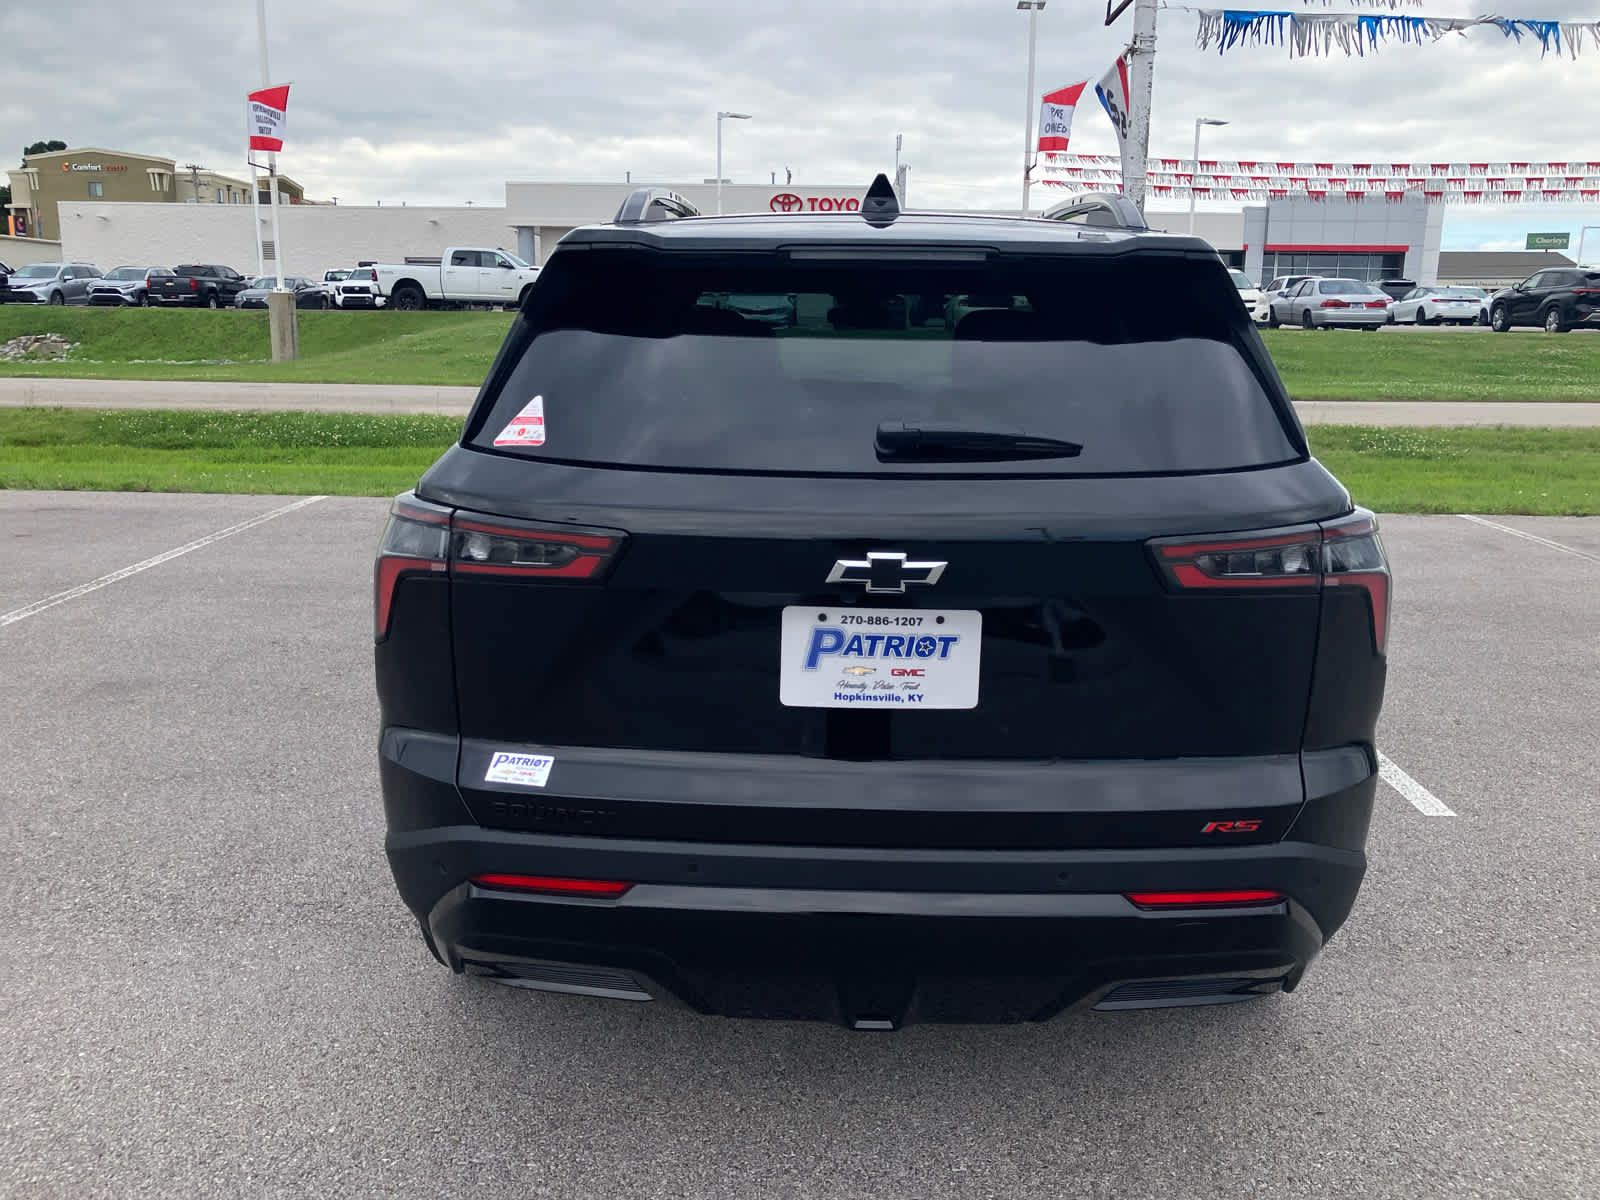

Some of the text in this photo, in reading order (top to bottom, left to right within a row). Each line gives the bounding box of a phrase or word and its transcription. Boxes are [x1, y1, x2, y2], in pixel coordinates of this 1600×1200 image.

[72, 163, 102, 171] Comfort
[807, 198, 860, 212] TOYO
[840, 615, 924, 627] 270-886-1207
[803, 626, 960, 671] PATRIOT
[890, 668, 926, 677] GMC
[833, 692, 925, 703] Hopkinsville, KY
[493, 754, 551, 769] PATRIOT
[1200, 820, 1263, 833] RS
